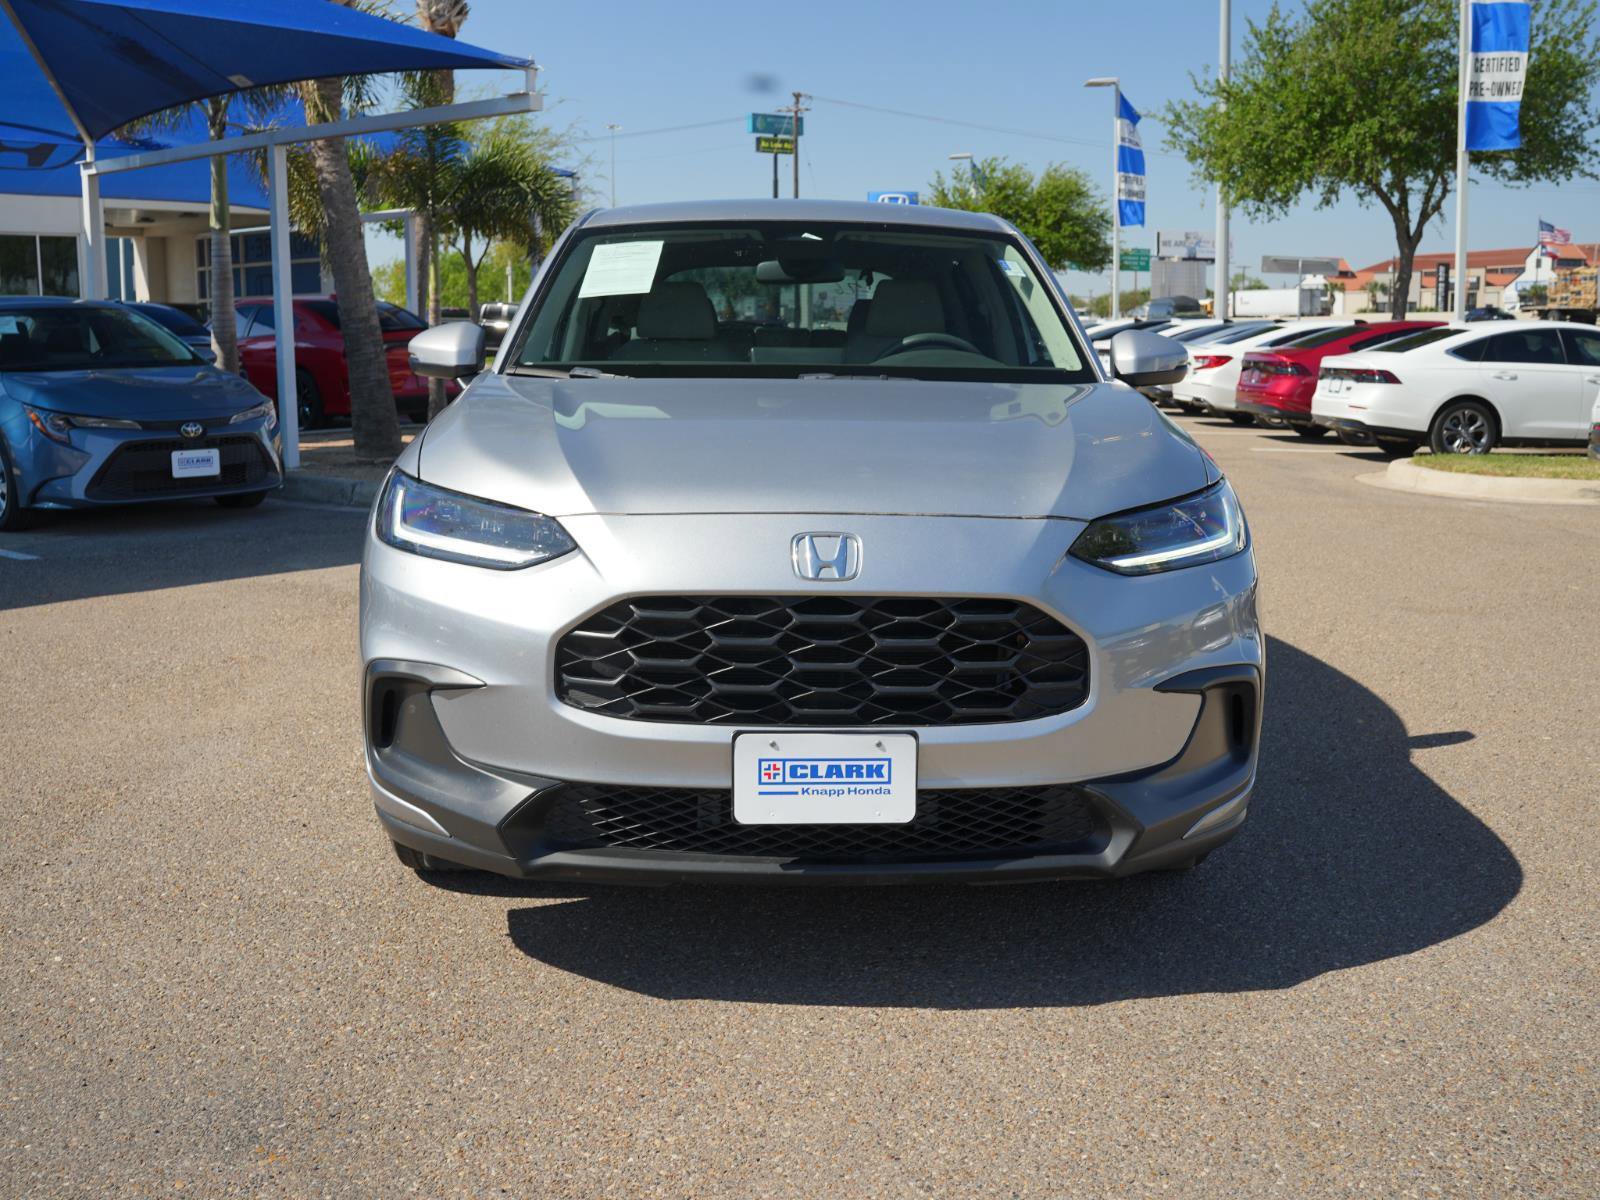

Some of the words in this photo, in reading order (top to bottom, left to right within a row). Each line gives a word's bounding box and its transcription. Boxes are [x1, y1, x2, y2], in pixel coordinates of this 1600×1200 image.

[1474, 57, 1520, 73] CERTIFIED
[1469, 81, 1522, 97] PRE-OWNED
[789, 764, 885, 779] CLARK
[801, 787, 845, 797] Knapp
[848, 787, 891, 796] Honda
